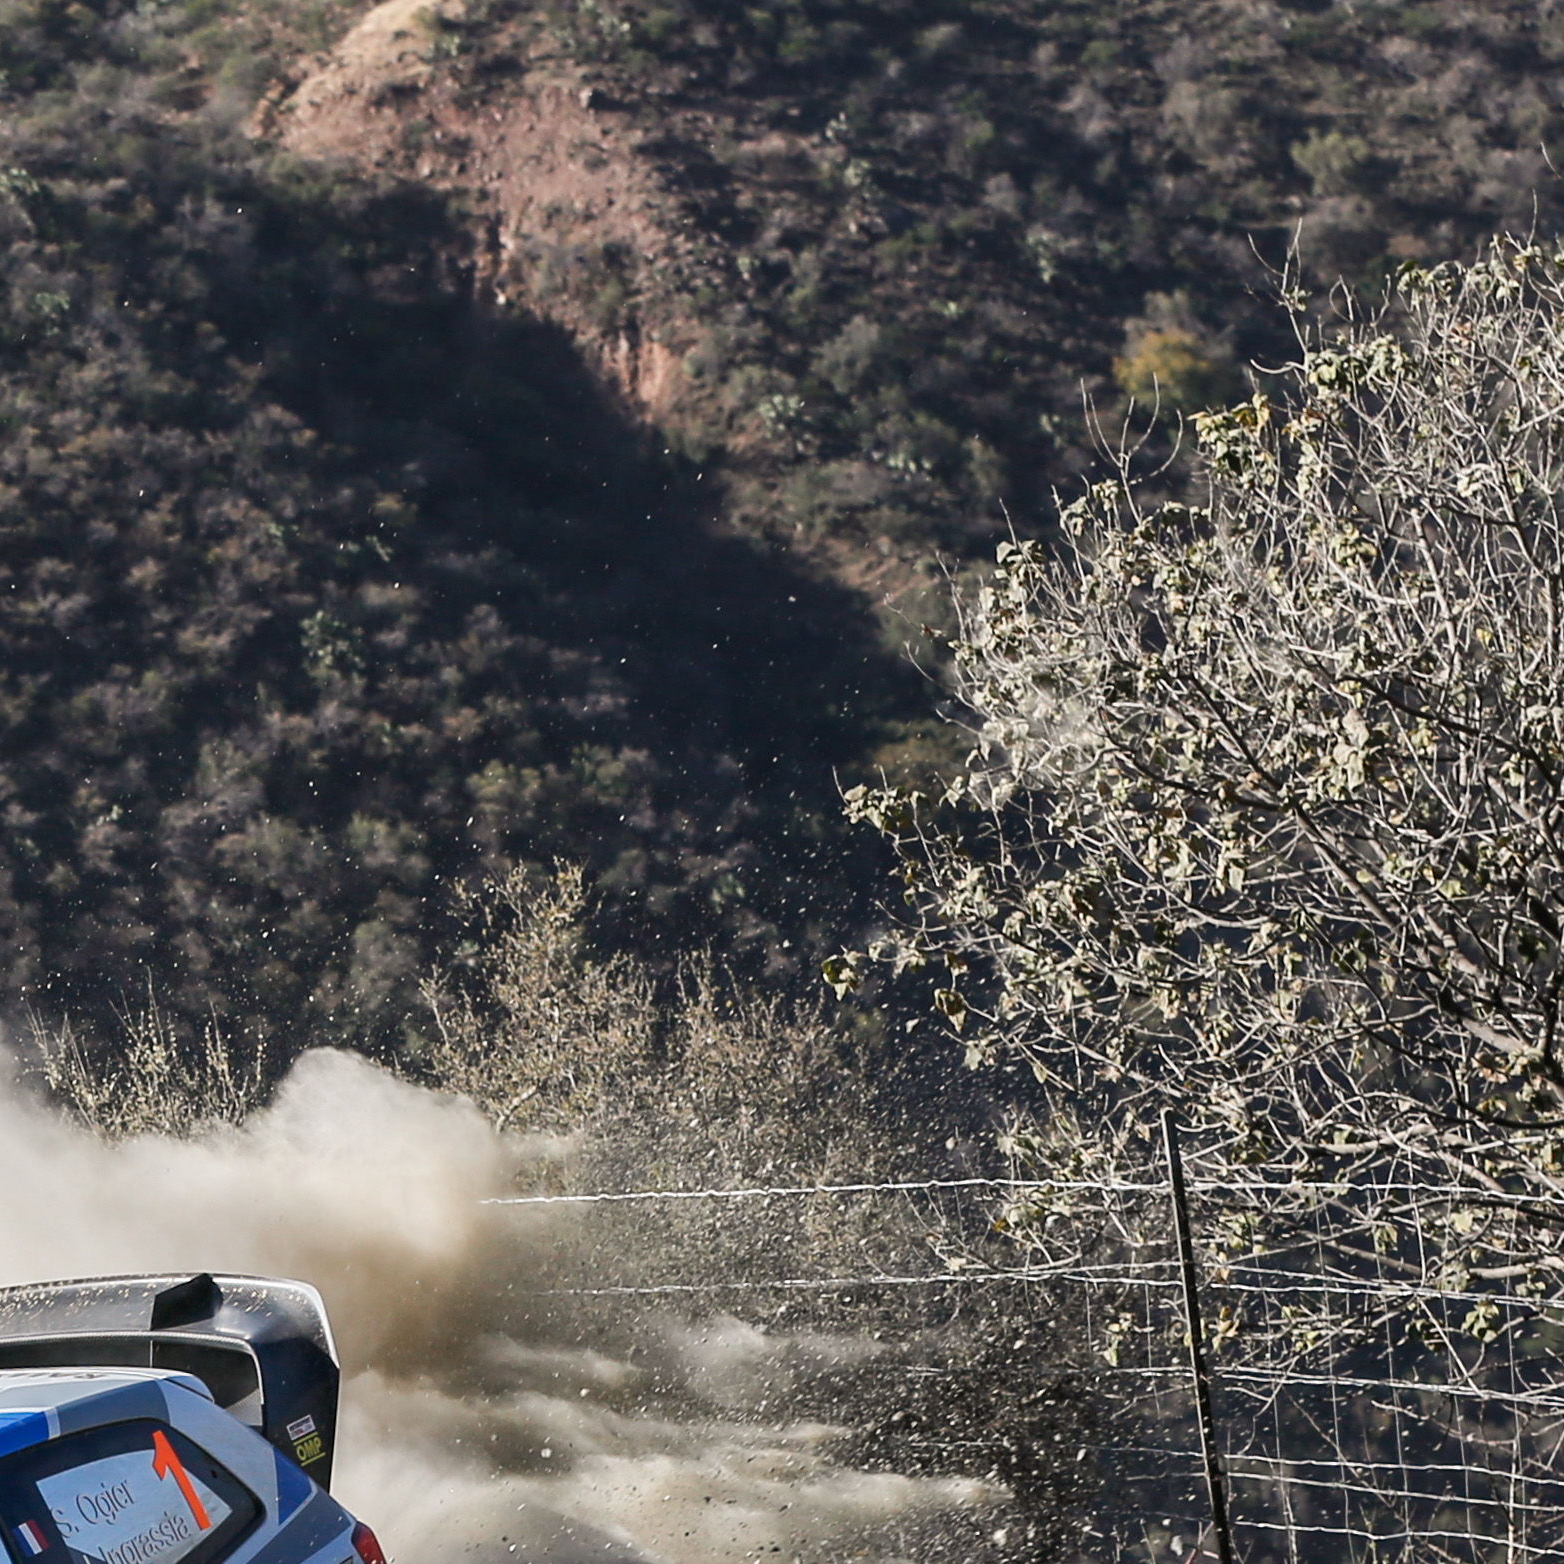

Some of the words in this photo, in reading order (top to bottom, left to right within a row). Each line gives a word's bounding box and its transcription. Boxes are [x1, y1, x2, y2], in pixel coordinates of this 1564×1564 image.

[296, 1437, 321, 1461] OMP
[50, 1507, 80, 1539] S.
[75, 1479, 135, 1525] Ogier
[152, 1430, 212, 1531] 1
